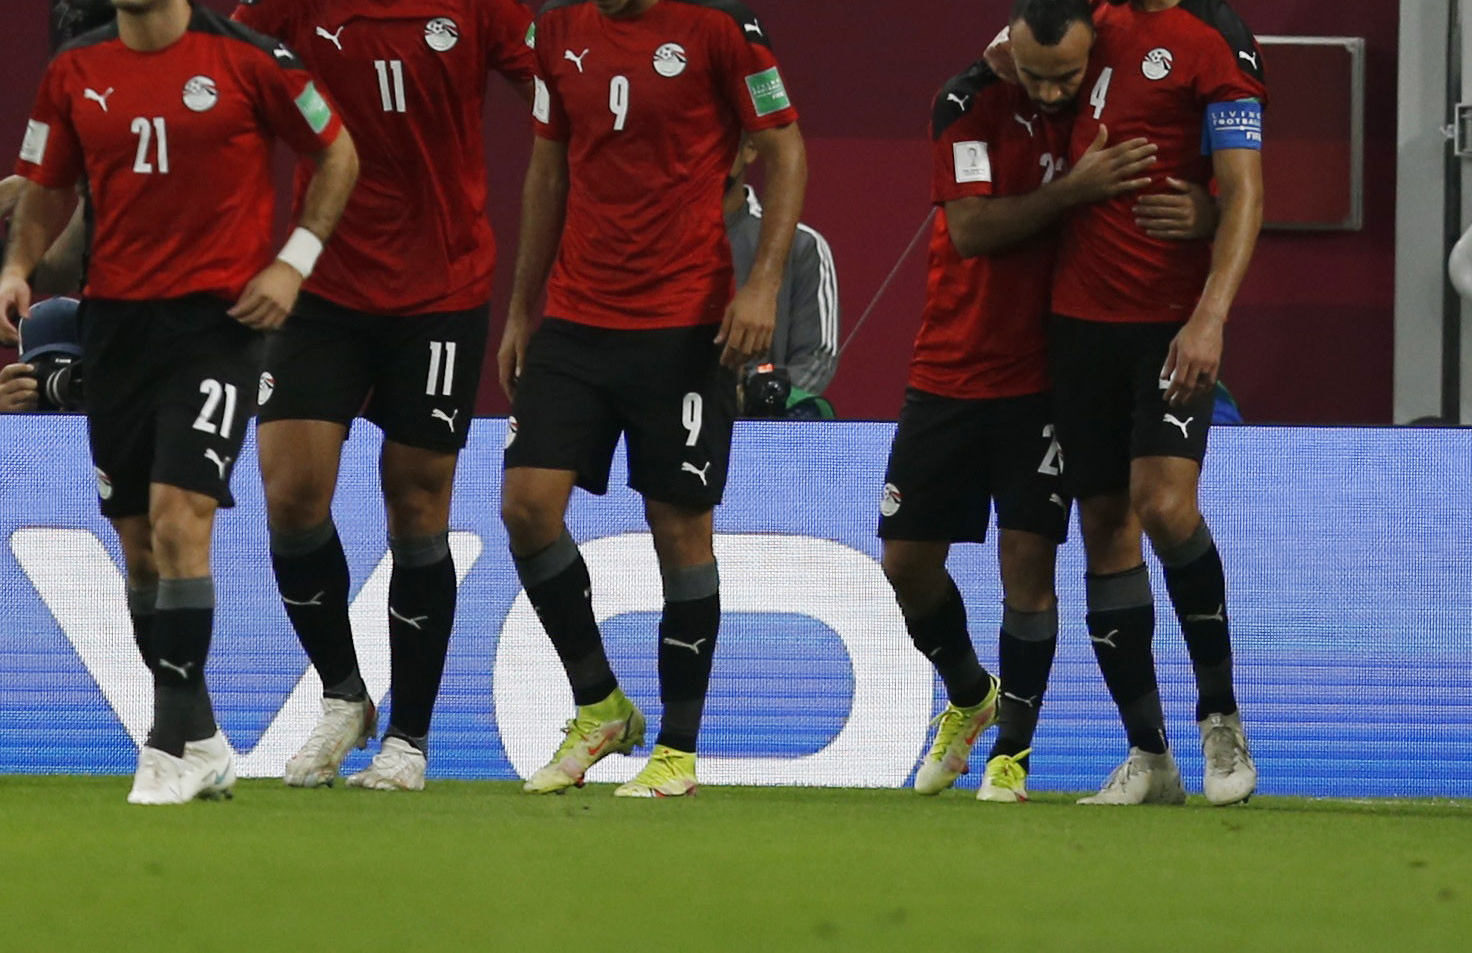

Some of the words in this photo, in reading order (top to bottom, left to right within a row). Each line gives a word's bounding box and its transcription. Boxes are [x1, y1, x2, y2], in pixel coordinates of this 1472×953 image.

[375, 60, 406, 113] 11
[609, 75, 629, 131] 9
[1090, 67, 1113, 120] 4
[130, 116, 169, 174] 21
[426, 341, 456, 396] 11
[192, 378, 237, 439] 21
[682, 392, 703, 447] 9
